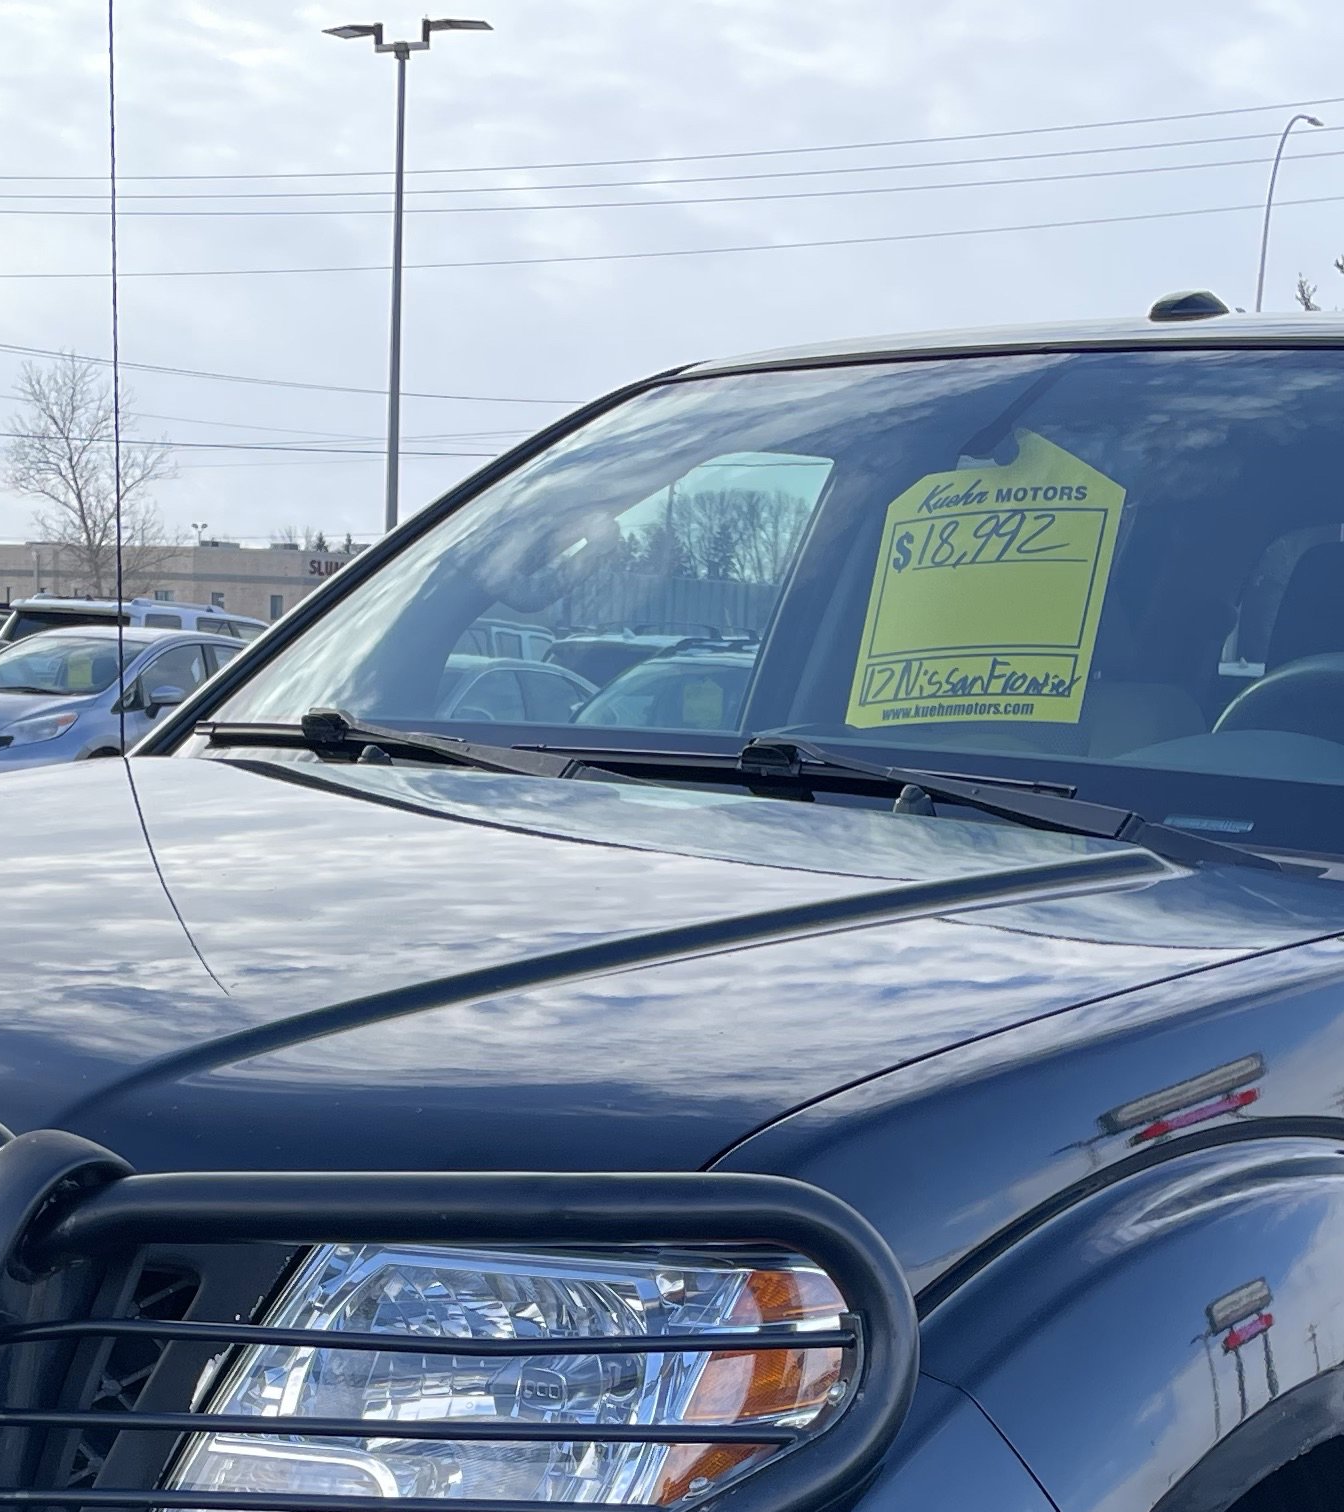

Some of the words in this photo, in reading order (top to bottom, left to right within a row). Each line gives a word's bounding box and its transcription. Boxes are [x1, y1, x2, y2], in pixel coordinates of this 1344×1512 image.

[917, 479, 990, 514] Kuehn
[995, 486, 1088, 503] MOTORS
[882, 702, 1035, 721] www.kuehnmotors.com
